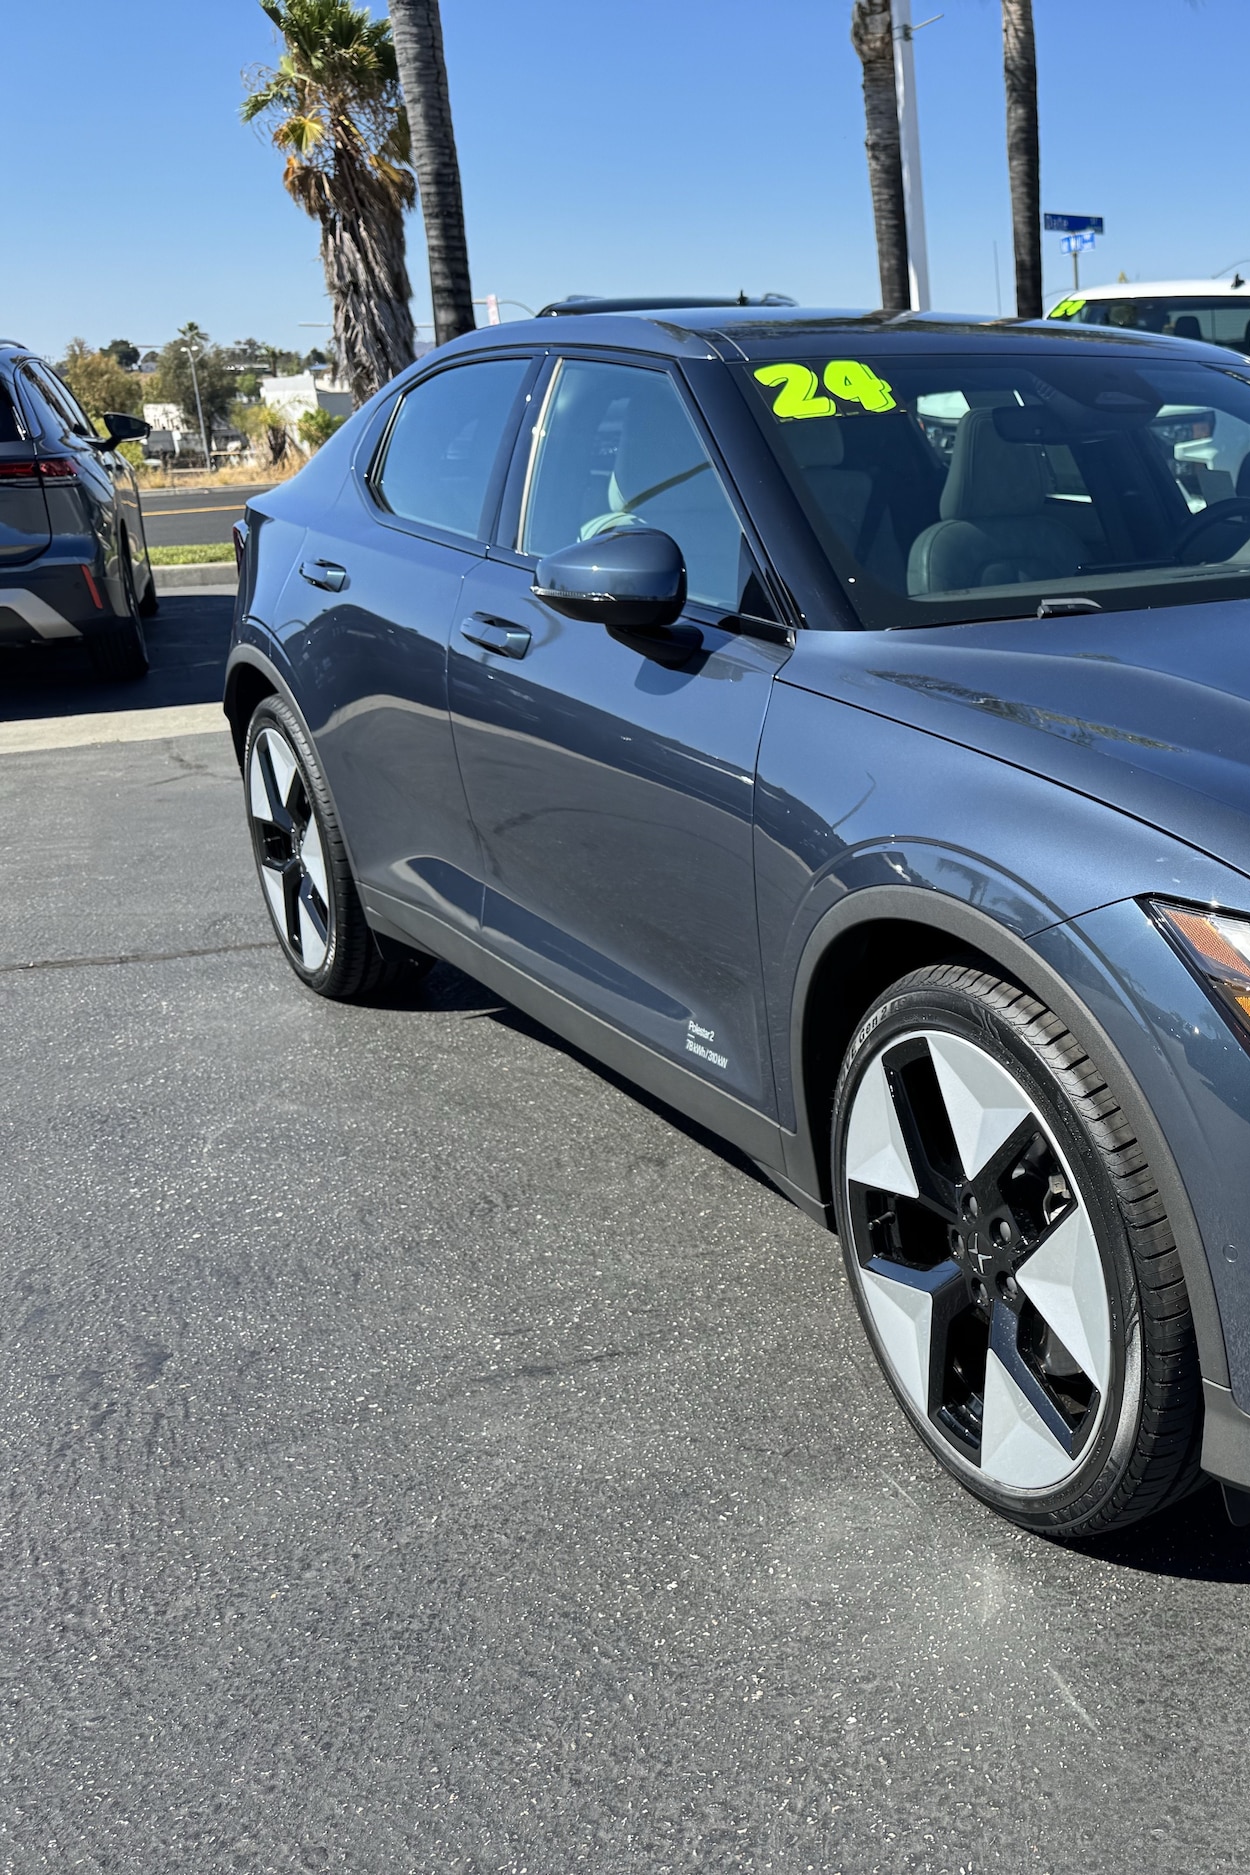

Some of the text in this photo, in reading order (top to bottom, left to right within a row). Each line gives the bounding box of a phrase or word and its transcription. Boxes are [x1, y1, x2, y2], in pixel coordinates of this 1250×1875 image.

[753, 360, 897, 419] 24
[688, 1020, 714, 1041] Polestar 2
